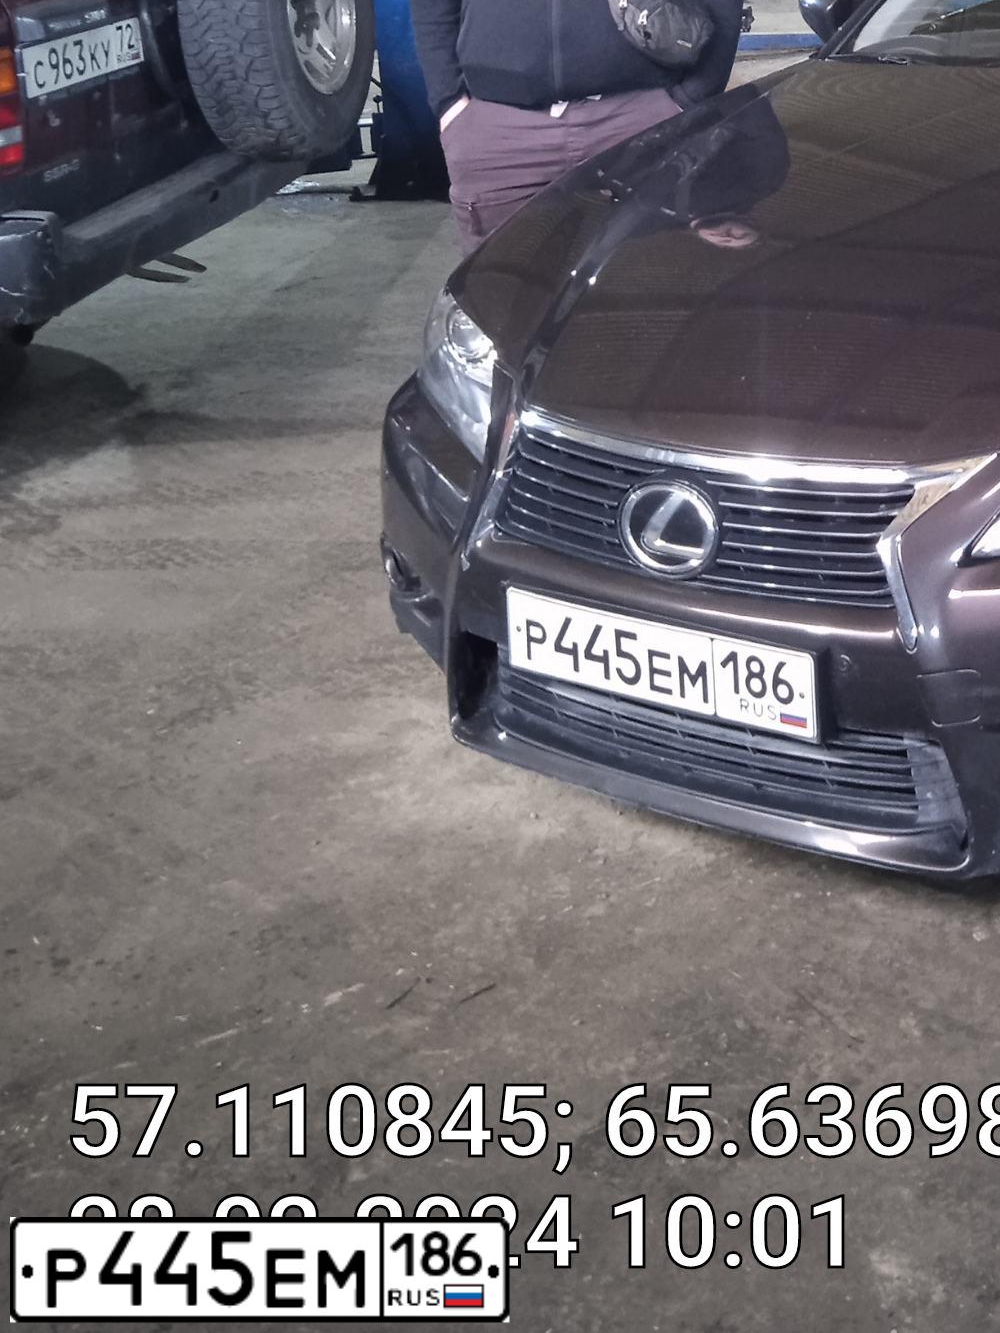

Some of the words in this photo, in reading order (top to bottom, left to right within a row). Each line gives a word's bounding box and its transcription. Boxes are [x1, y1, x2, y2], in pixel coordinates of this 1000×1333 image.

[115, 23, 135, 53] 72
[525, 616, 710, 704] Р445ЕМ
[720, 650, 795, 705] 186
[739, 697, 778, 721] RUS
